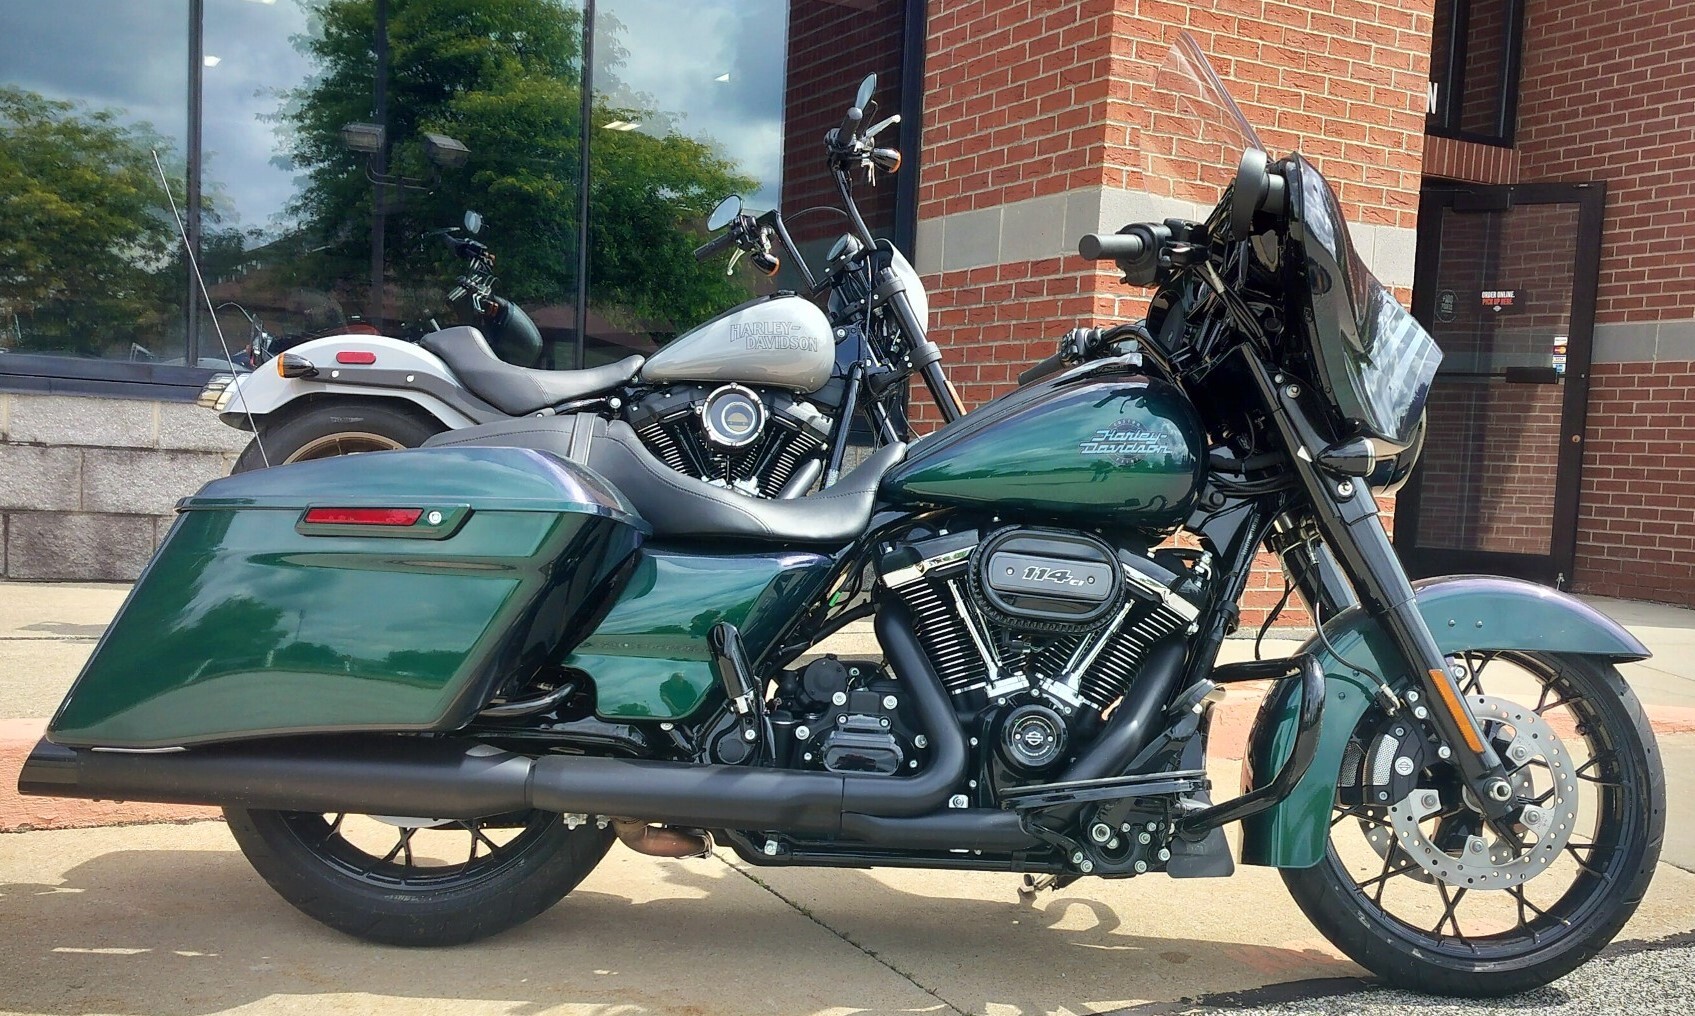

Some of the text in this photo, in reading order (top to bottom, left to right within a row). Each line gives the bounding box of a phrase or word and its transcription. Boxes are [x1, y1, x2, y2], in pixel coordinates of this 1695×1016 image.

[745, 335, 818, 352] DAVIDSON
[1092, 429, 1168, 445] Harley-
[1080, 442, 1173, 454] Davidson
[1022, 565, 1074, 584] 114
